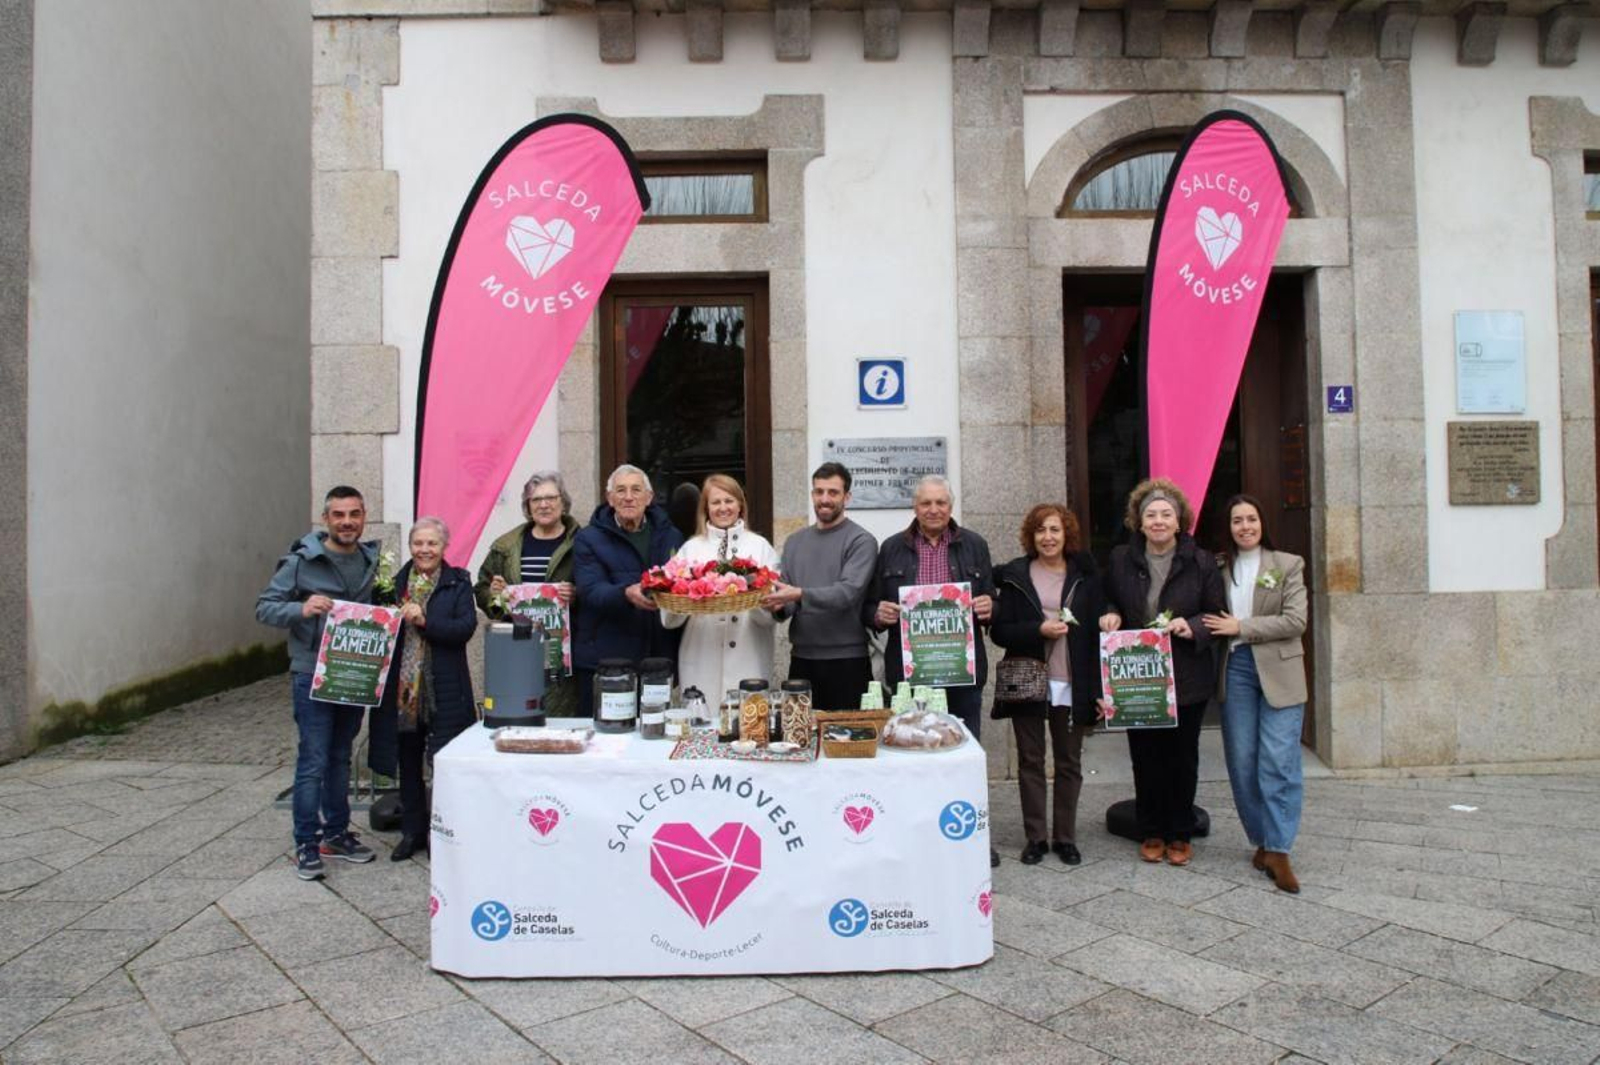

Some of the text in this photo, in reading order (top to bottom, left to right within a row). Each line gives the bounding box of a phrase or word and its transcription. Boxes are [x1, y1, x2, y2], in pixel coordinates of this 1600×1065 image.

[488, 180, 602, 223] SALCEDA
[1180, 173, 1260, 218] SALCEDA
[1179, 263, 1257, 304] MÓVESE
[479, 275, 590, 314] MÓVESE
[1334, 387, 1347, 405] 4
[888, 445, 934, 453] PROVINCIAL
[910, 617, 965, 635] CAMELIA
[331, 634, 385, 657] CAMELIA
[1111, 662, 1165, 679] CAMELIA
[513, 912, 557, 923] Salceda
[870, 909, 913, 920] Salceda
[513, 924, 575, 935] de Caselas
[870, 919, 929, 930] de Caselas
